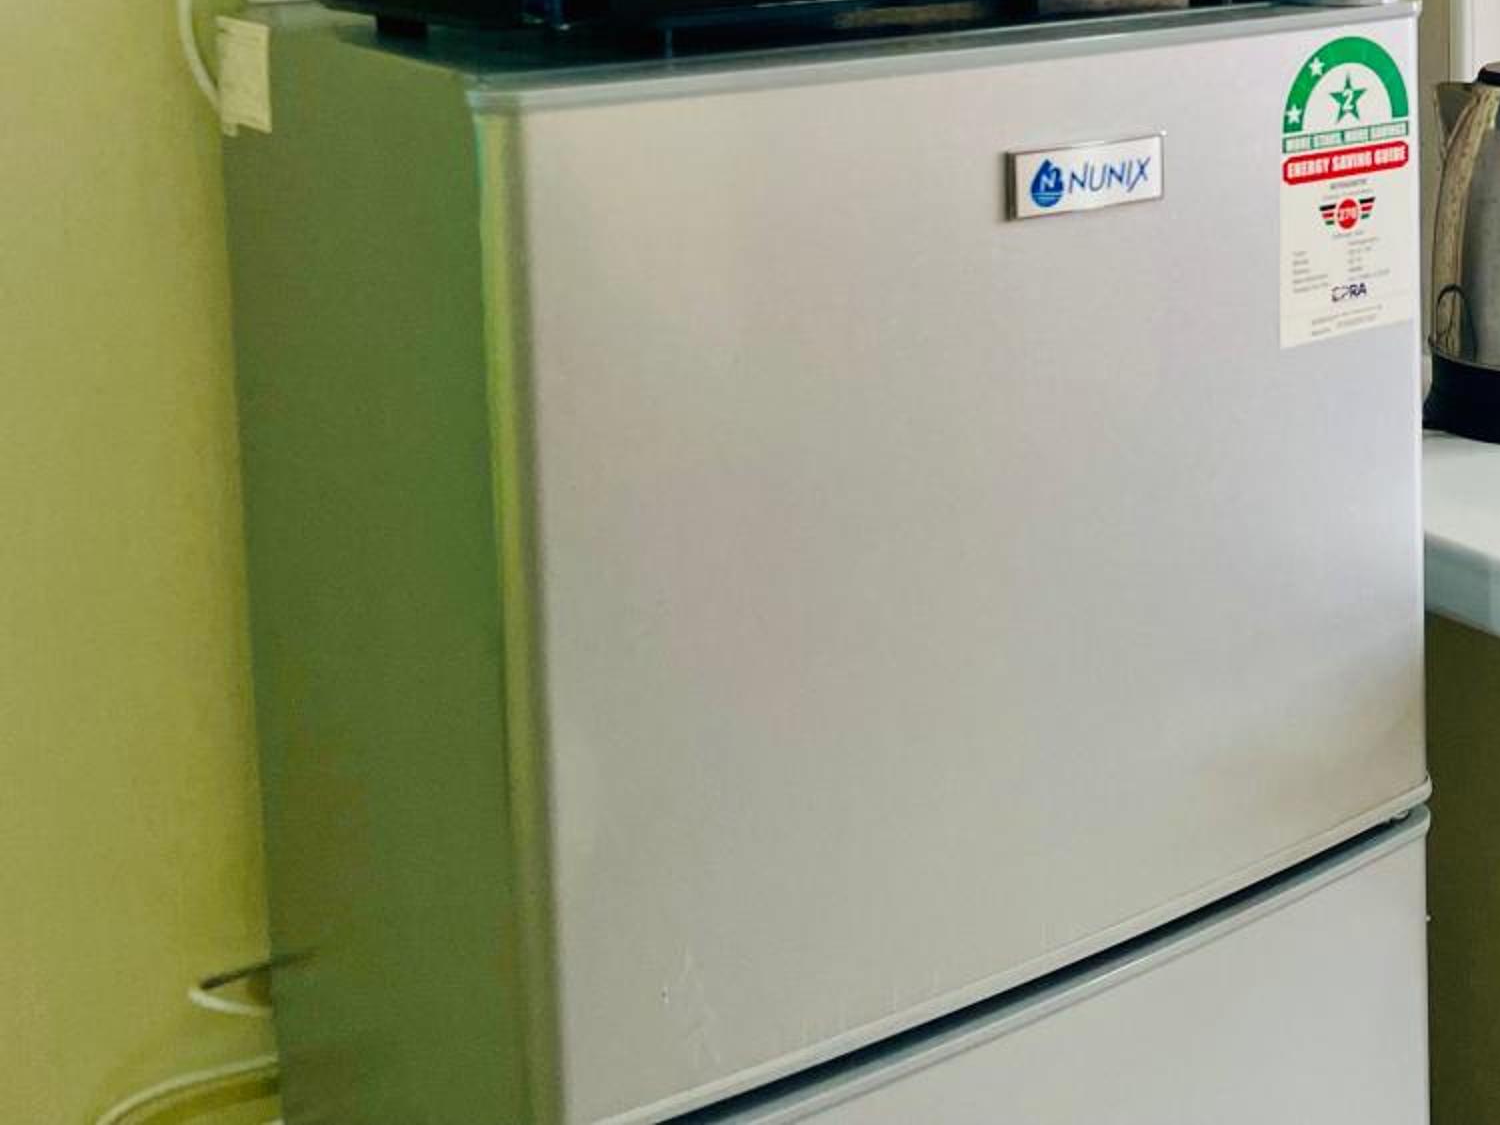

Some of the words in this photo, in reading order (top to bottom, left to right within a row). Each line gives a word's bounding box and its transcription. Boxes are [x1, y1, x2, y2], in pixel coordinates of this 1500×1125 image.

[1342, 87, 1355, 110] 2
[1068, 156, 1151, 194] NUNIX
[1287, 156, 1330, 178] ENERGY
[1331, 150, 1373, 172] SAVING
[1374, 143, 1406, 165] GUIDE
